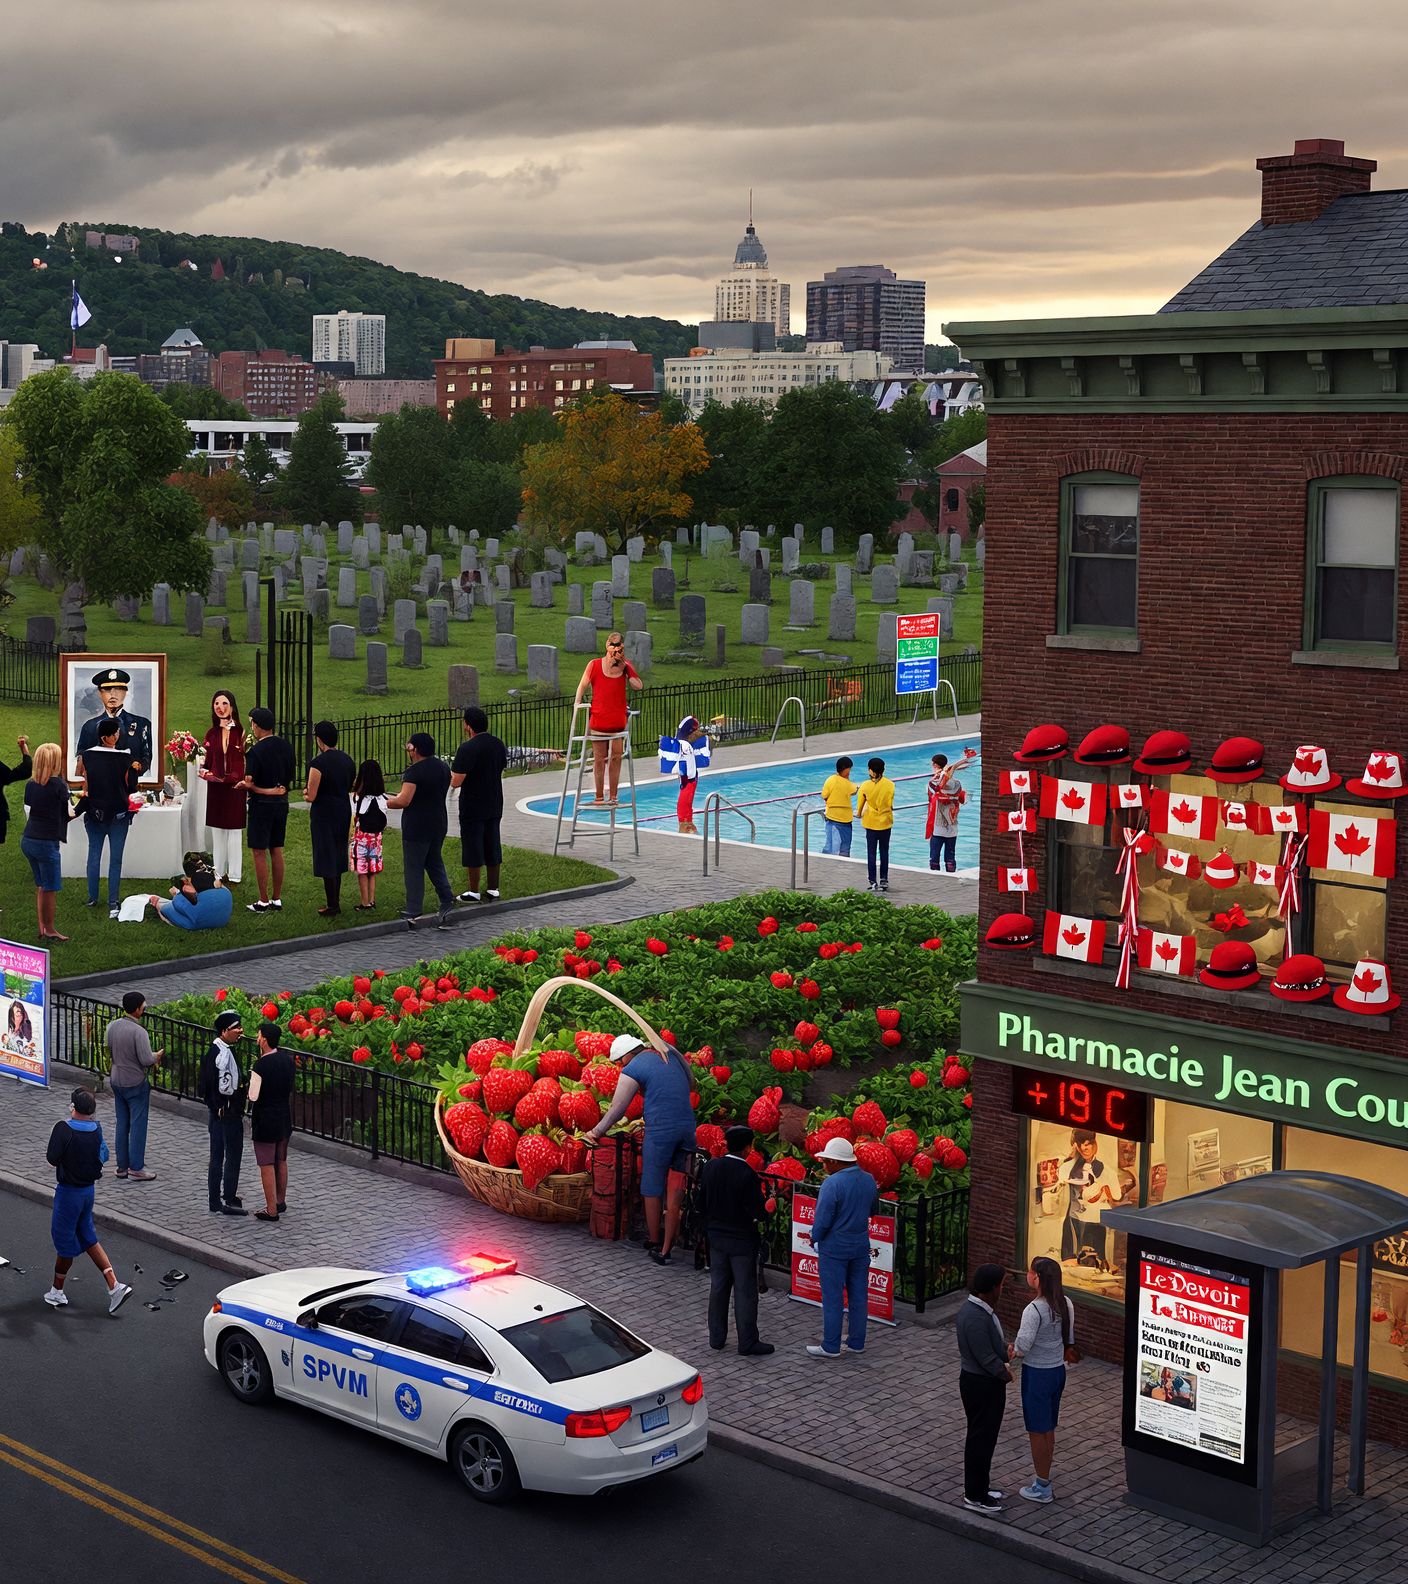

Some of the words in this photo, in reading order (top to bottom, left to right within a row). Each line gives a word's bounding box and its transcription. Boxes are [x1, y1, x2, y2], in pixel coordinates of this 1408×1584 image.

[998, 1012, 1204, 1087] Pharmacie
[1215, 1055, 1310, 1109] Jean
[1145, 1265, 1166, 1288] Le
[1168, 1271, 1240, 1308] Devoir
[303, 1354, 369, 1398] SPVM
